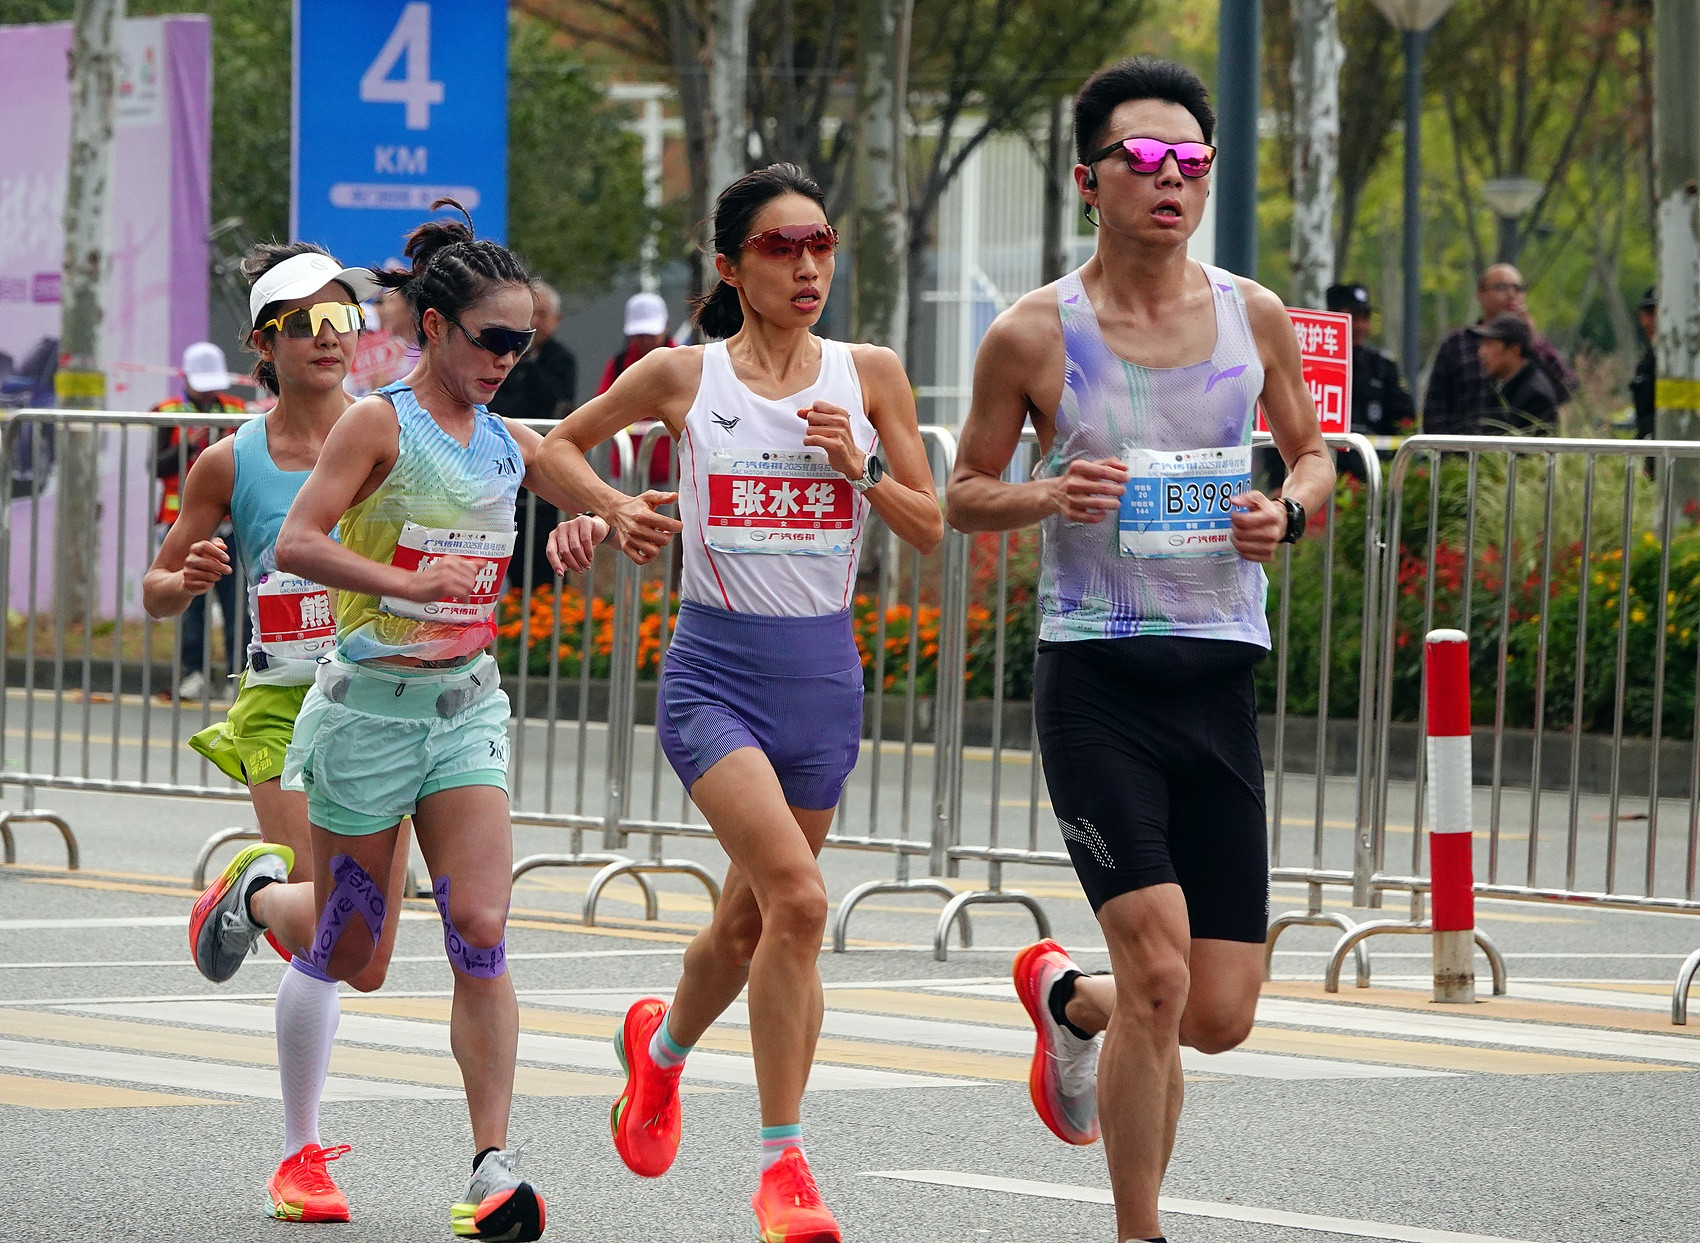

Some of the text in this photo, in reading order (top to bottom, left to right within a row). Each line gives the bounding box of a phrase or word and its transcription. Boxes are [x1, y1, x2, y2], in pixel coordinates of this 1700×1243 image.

[360, 2, 446, 130] 4
[375, 146, 428, 175] KM
[732, 460, 835, 472] 广汽传祺 2025宜昌马拉
[732, 480, 836, 518] 张水华
[768, 532, 815, 541] 广汽传祺
[1186, 534, 1228, 544] 广汽传祺
[300, 594, 331, 629] 熊
